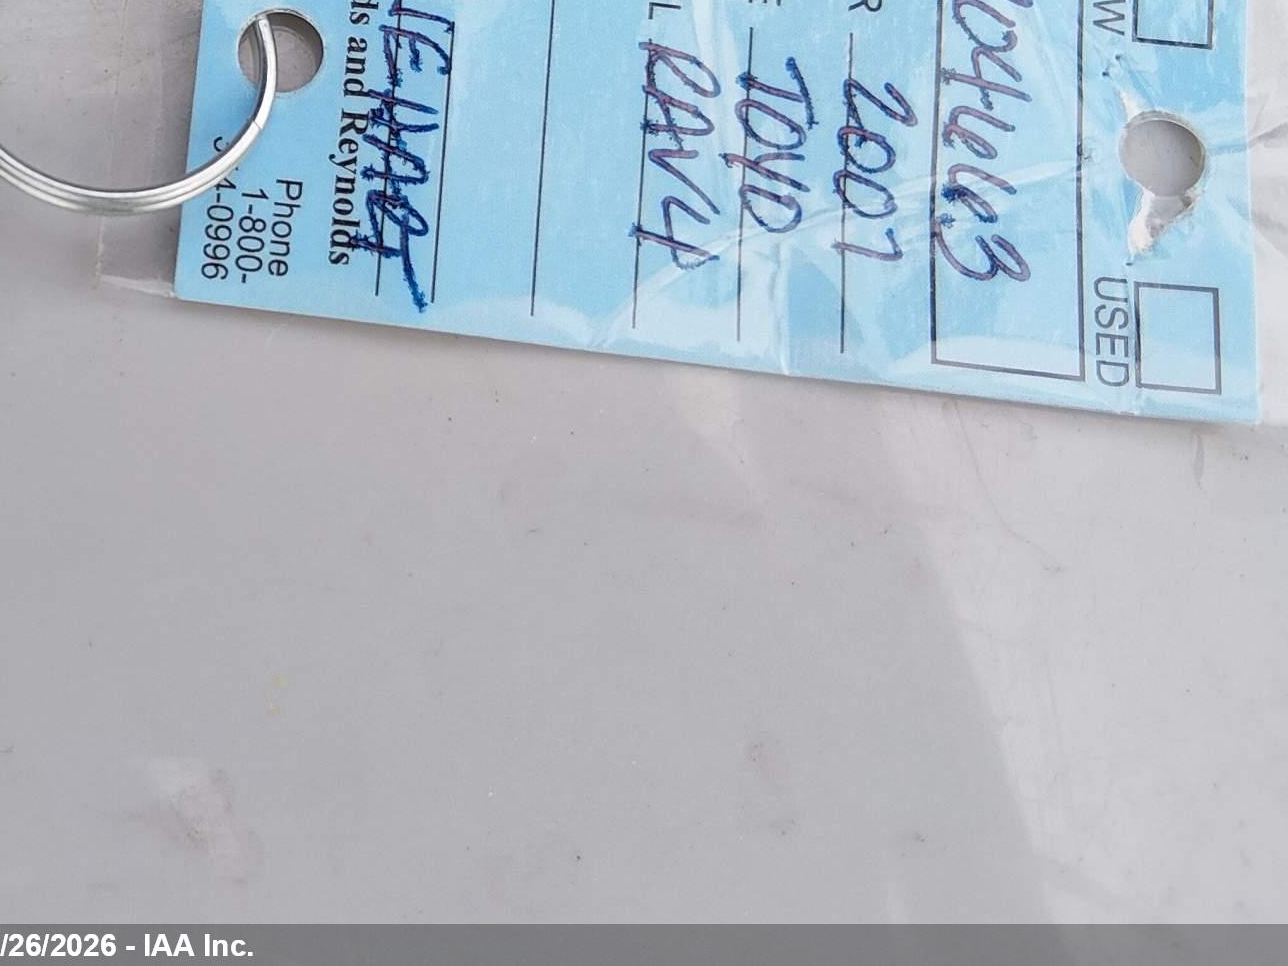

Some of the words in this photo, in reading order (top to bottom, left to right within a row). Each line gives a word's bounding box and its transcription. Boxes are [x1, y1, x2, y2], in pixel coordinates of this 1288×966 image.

[343, 36, 370, 97] and
[201, 136, 238, 280] 4-0996
[328, 108, 370, 266] Reynolds
[629, 40, 720, 271] RAV4
[831, 78, 918, 264] 2007
[235, 188, 269, 284] 1-800-
[268, 178, 303, 277] Phone
[1093, 276, 1130, 388] USED
